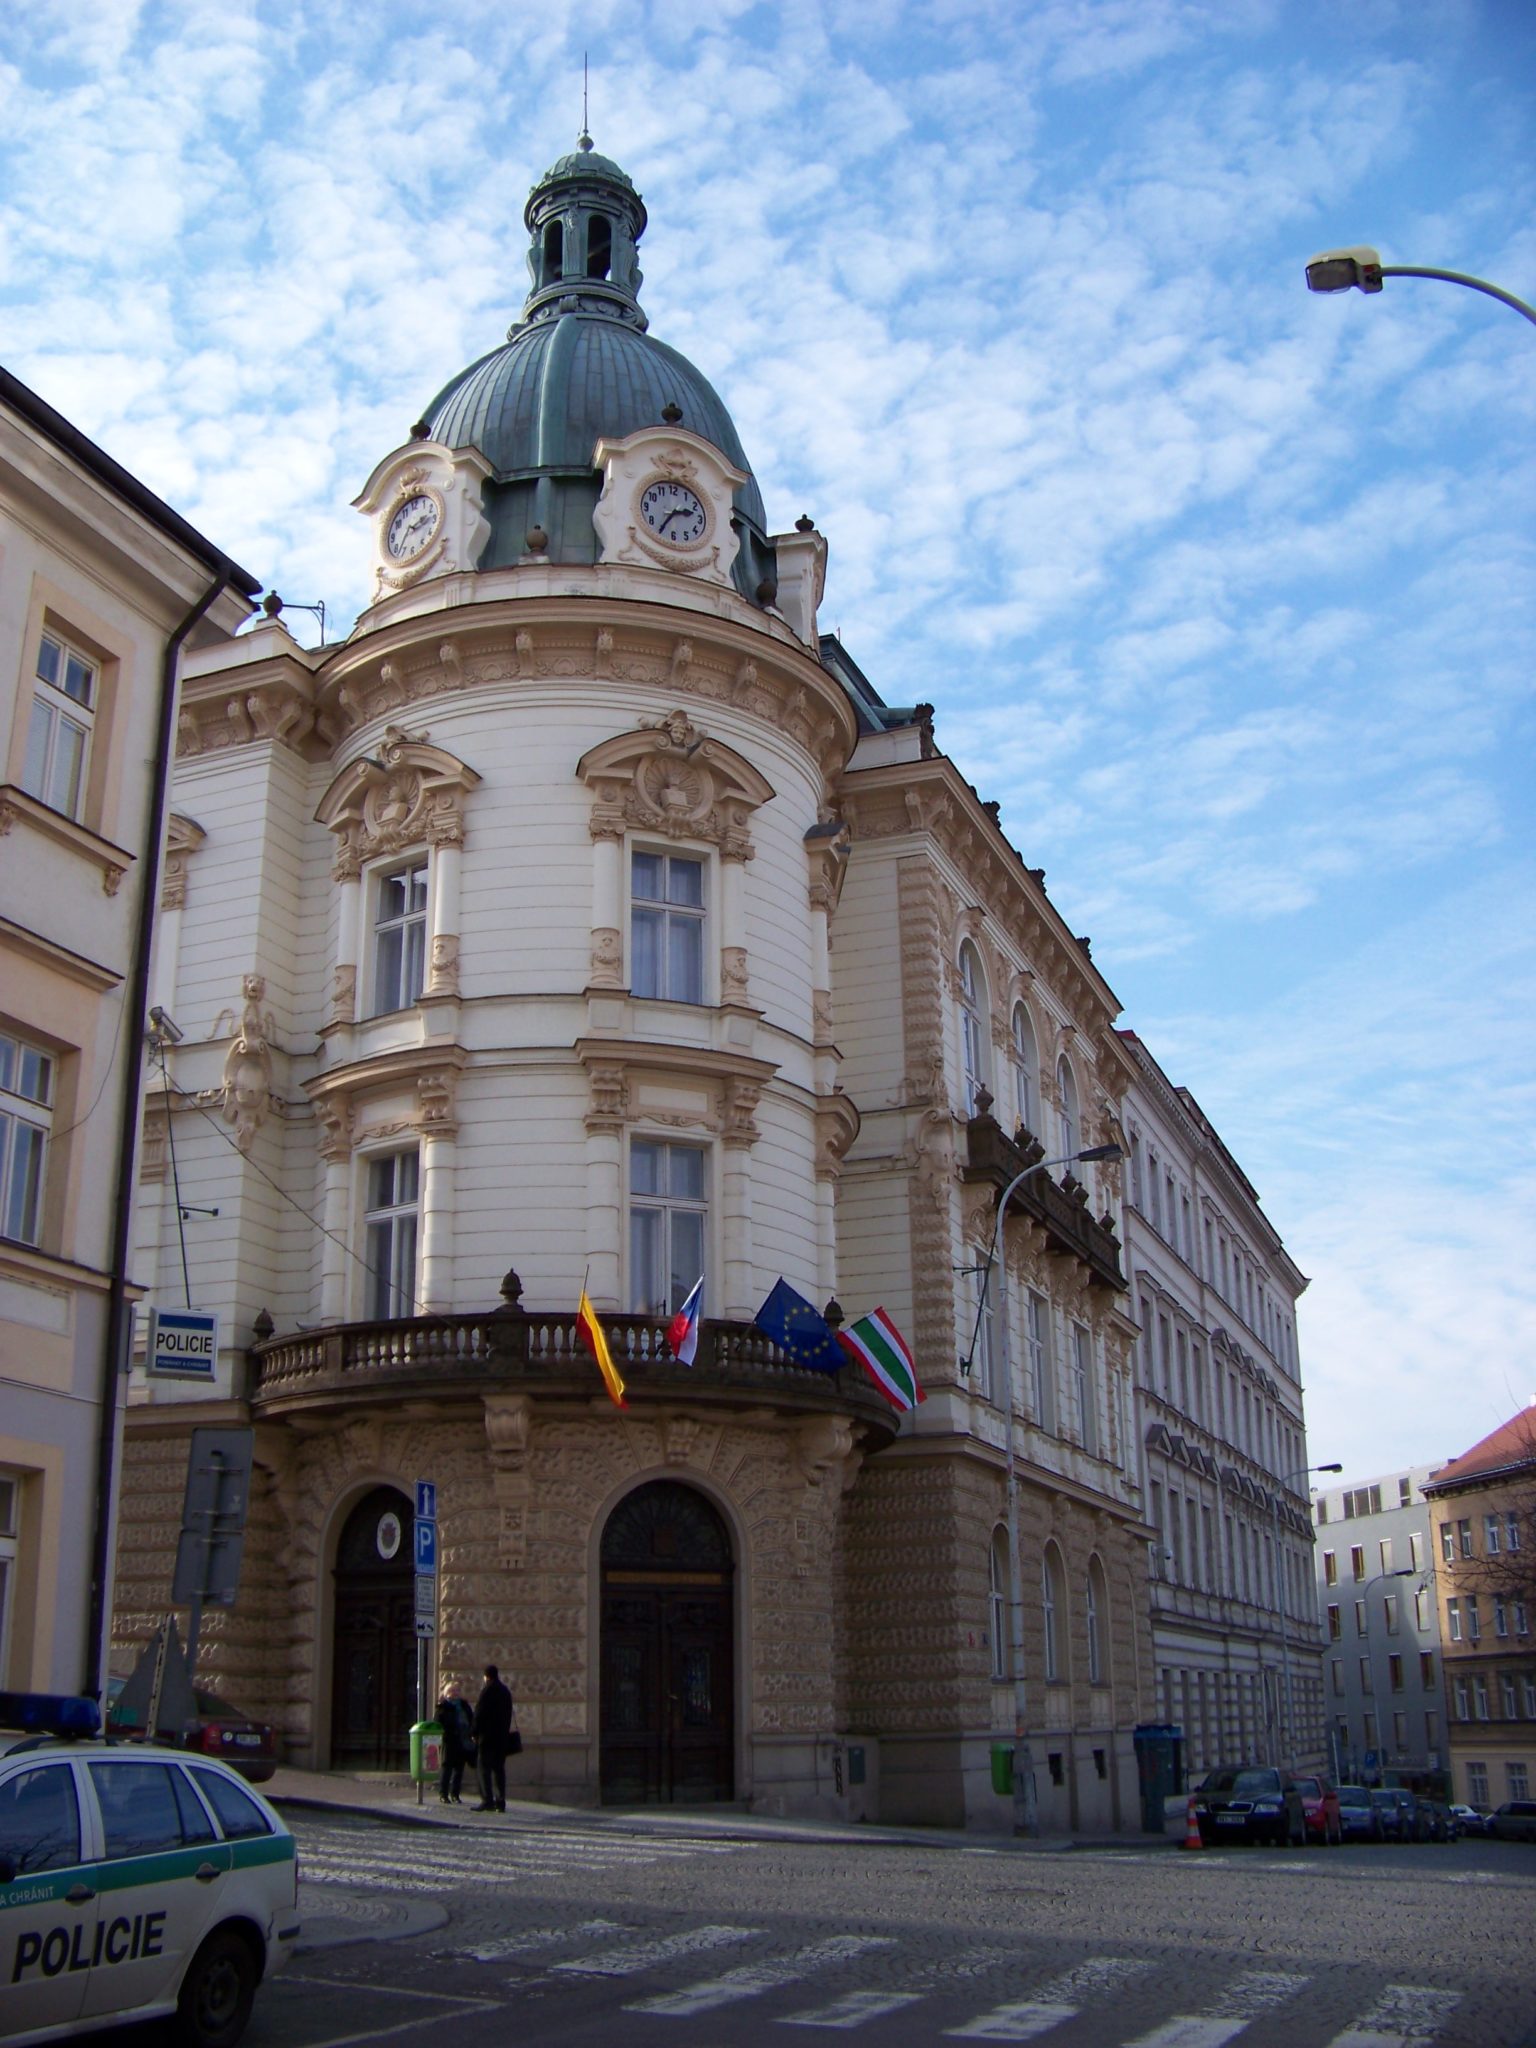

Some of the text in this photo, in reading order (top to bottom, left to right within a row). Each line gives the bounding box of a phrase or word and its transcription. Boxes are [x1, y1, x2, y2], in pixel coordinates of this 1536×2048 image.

[657, 486, 665, 496] 11
[669, 485, 678, 496] 12
[648, 491, 657, 502] 10
[684, 492, 688, 501] 1
[411, 499, 418, 511] 12
[422, 499, 426, 509] 1
[429, 504, 433, 513] 2
[644, 502, 649, 512] 9
[692, 501, 698, 511] 2
[402, 508, 408, 519] 11
[432, 514, 437, 524] 3
[649, 515, 654, 525] 8
[697, 515, 703, 525] 3
[395, 519, 402, 530] 10
[692, 525, 698, 535] 4
[391, 533, 395, 543] 9
[671, 530, 676, 541] 6
[683, 530, 689, 541] 5
[394, 544, 399, 553] 8
[401, 546, 407, 557] 7
[156, 1332, 213, 1353] POLICIE
[420, 1527, 431, 1556] P
[1367, 1753, 1374, 1762] P
[0, 1886, 54, 1906] A CHRÁNIT
[11, 1910, 167, 1983] POLICIE
